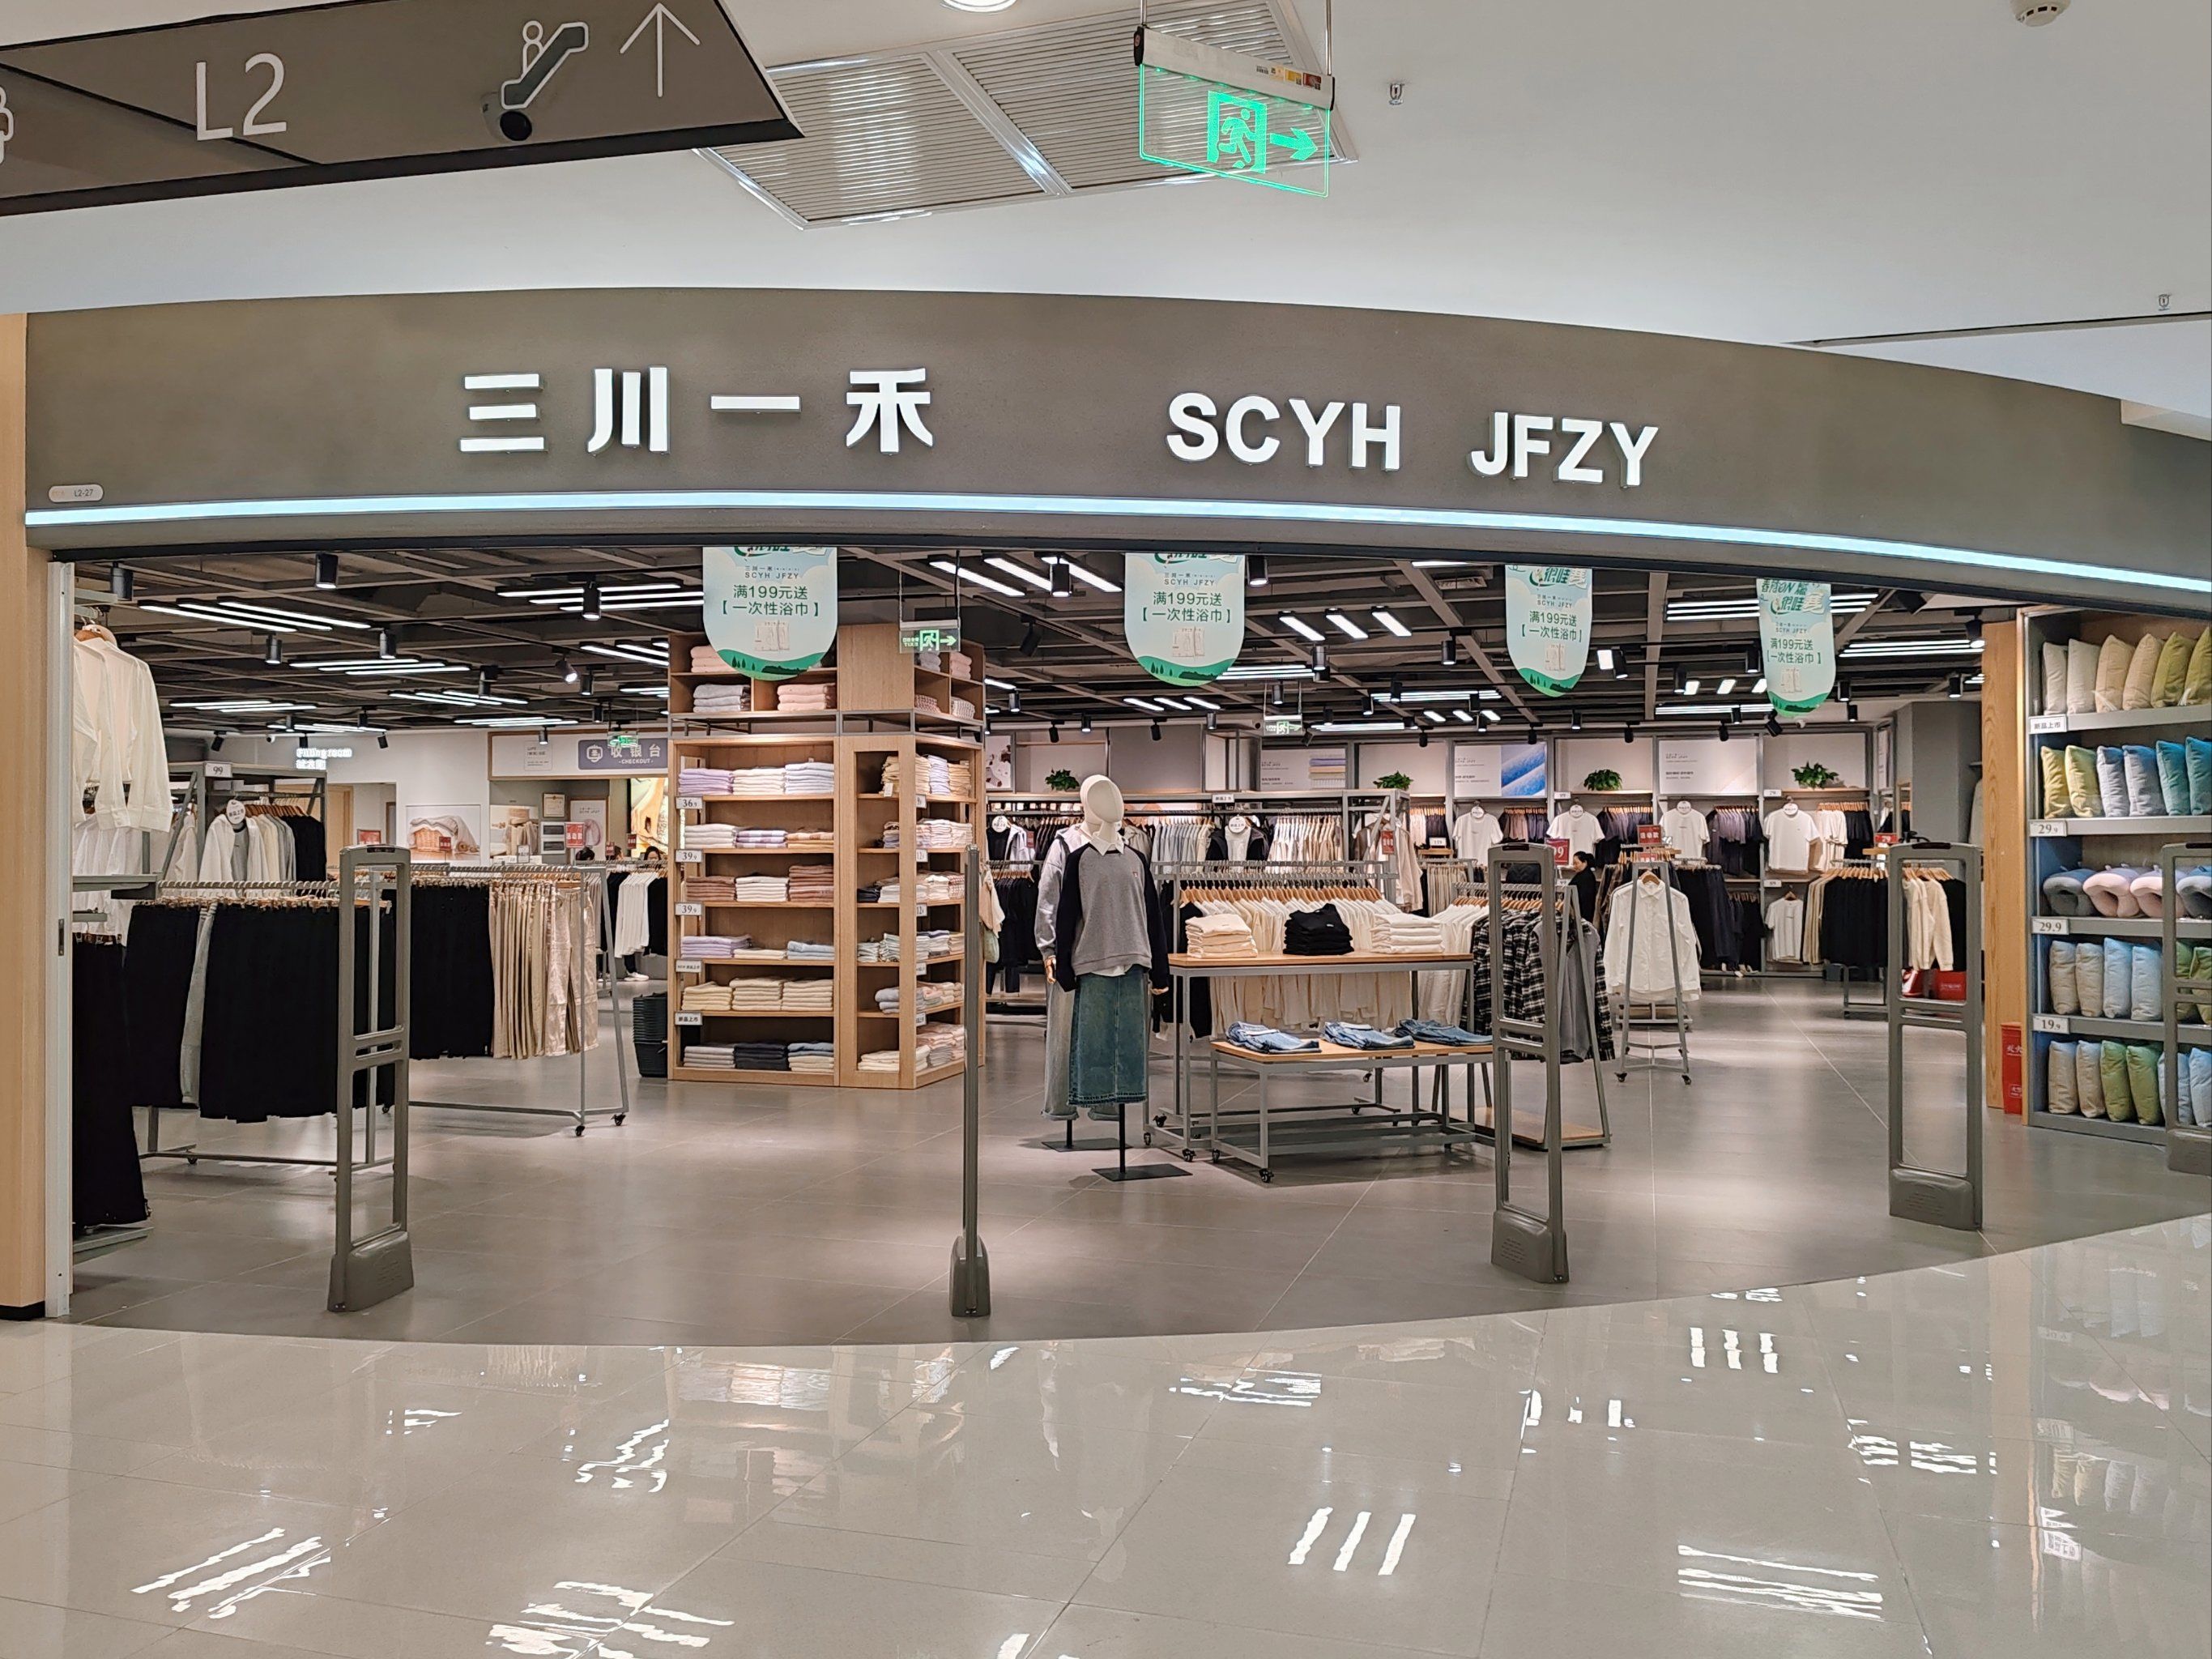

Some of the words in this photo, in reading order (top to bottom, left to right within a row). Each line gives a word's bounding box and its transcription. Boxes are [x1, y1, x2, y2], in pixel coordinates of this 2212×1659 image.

[196, 53, 287, 141] L2
[460, 367, 934, 454] 三川一禾
[1166, 392, 1401, 471] SCYH
[1470, 412, 1660, 487] JFZY
[74, 488, 94, 497] L2-27
[744, 571, 771, 579] SCYH
[775, 572, 799, 580] JFZY
[733, 584, 808, 600] 满199元送
[1153, 591, 1222, 607] 满199元送
[1529, 610, 1578, 627] 满199元送
[610, 744, 661, 758] 收银台
[213, 766, 224, 775] 99
[2039, 920, 2062, 932] 29.9
[2041, 1019, 2061, 1031] 19.9
